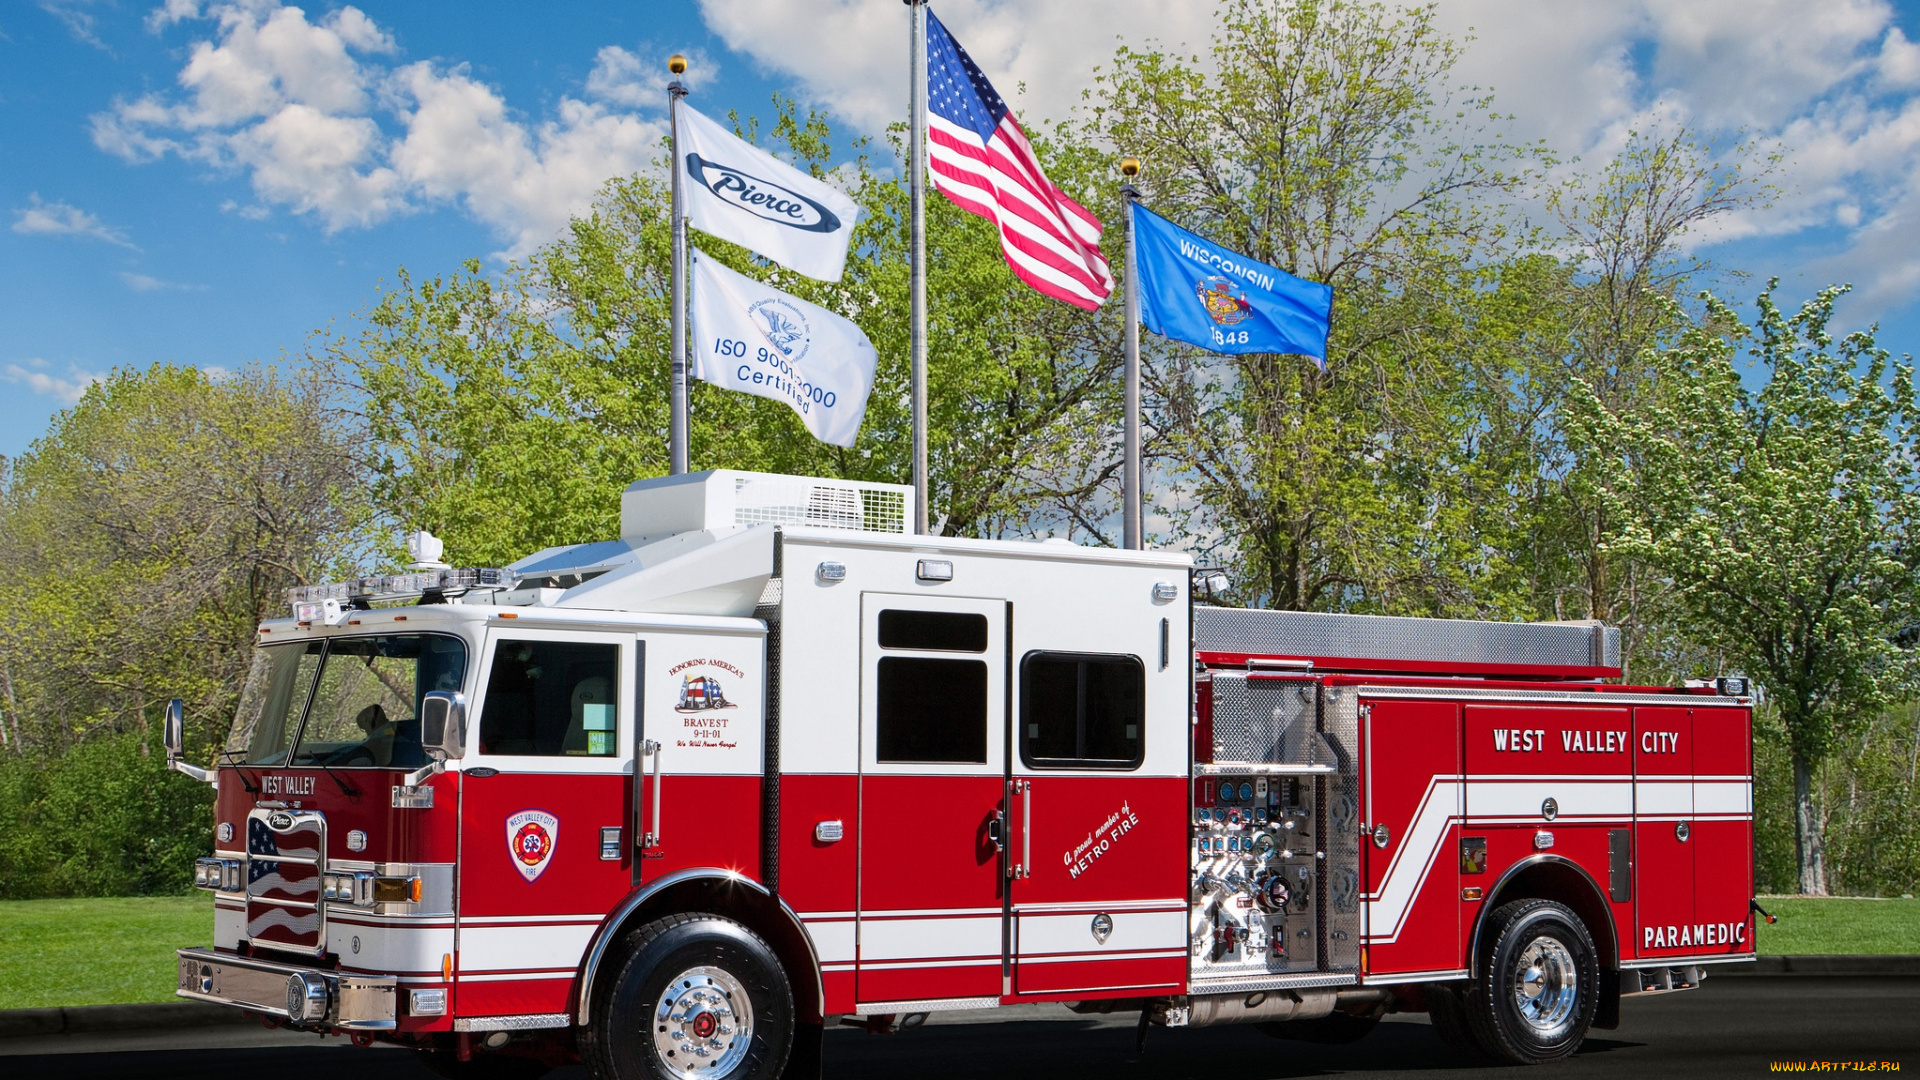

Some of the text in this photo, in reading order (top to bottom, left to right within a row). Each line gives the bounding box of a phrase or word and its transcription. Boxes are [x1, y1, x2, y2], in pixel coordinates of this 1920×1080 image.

[712, 172, 804, 219] Pierce
[1180, 239, 1275, 292] WISCONSIN
[1210, 326, 1249, 346] 1848
[714, 338, 747, 358] ISO
[737, 365, 810, 414] Certified
[668, 658, 745, 679] HONORING AMERICA'S
[683, 718, 729, 728] BRAVEST
[693, 729, 721, 738] 9-11-01
[1493, 729, 1679, 754] WEST VALLEY CITY
[261, 775, 316, 795] WEST VALLEY
[509, 813, 556, 827] WEST VALLEY CITY
[1073, 832, 1093, 862] proud
[1095, 812, 1120, 838] member
[1121, 799, 1129, 815] of
[1069, 812, 1139, 880] METRO FIRE
[525, 868, 537, 876] FIRE
[1643, 922, 1746, 949] PARAMEDIC
